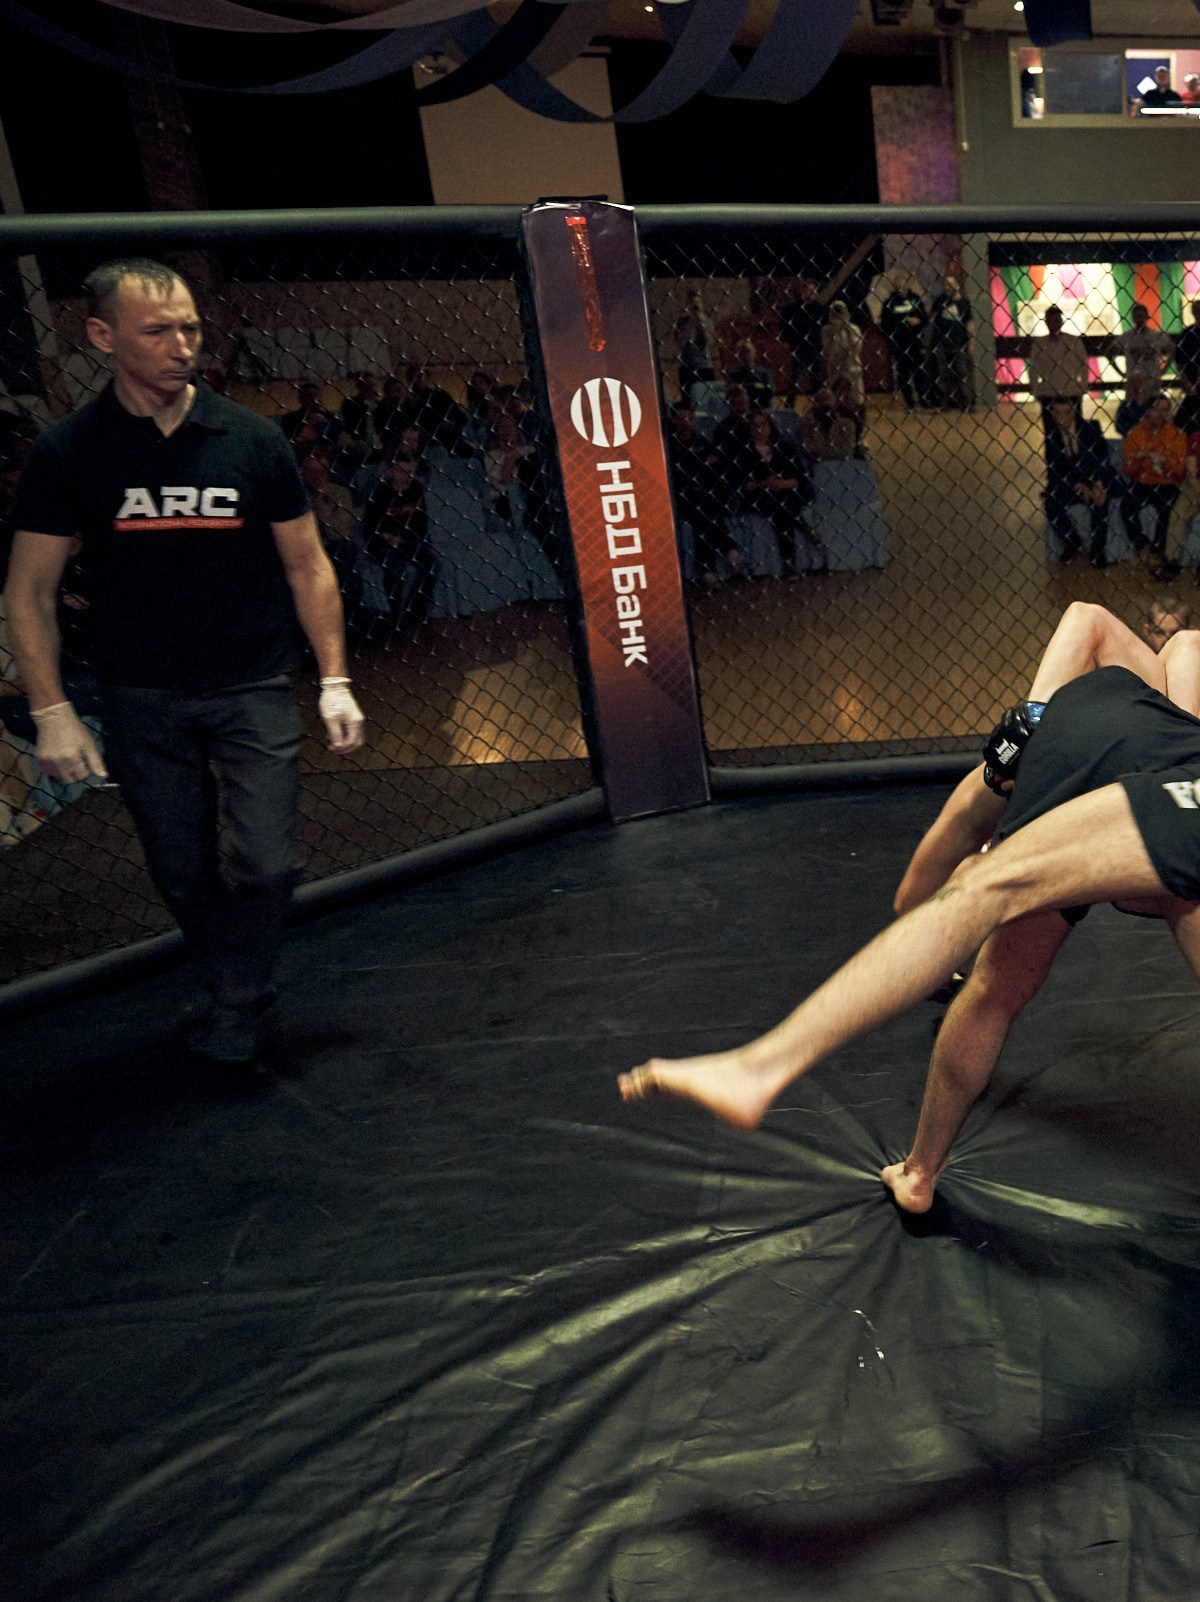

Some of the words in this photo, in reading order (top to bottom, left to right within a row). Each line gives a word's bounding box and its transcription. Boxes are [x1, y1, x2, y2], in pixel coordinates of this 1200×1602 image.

[115, 486, 240, 519] ARC
[596, 460, 643, 559] НБД
[611, 564, 649, 668] Банк
